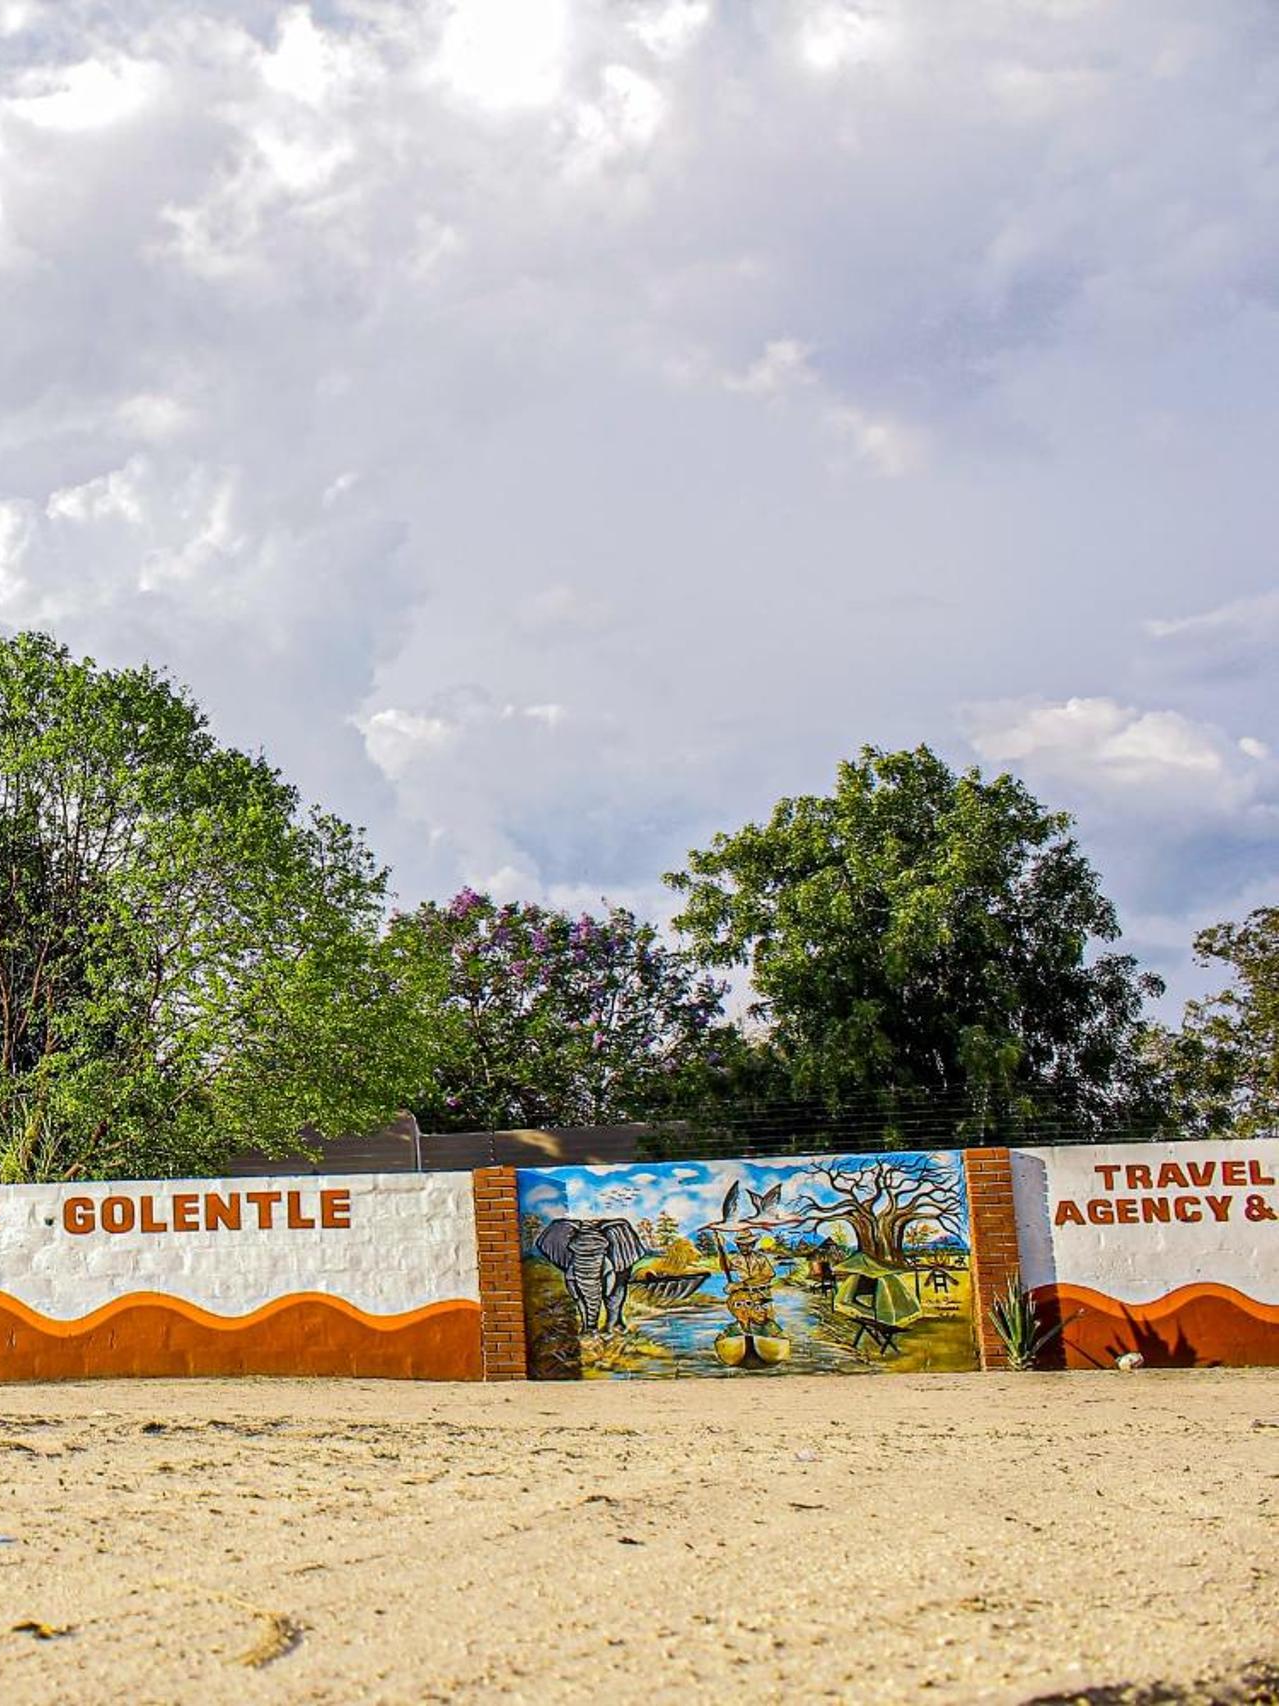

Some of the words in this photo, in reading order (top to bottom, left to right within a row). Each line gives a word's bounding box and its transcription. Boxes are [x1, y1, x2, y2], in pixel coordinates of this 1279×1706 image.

[1094, 1160, 1275, 1191] TRAVEL
[62, 1189, 351, 1234] GOLENTLE
[1054, 1195, 1233, 1226] AGENCY
[1245, 1194, 1278, 1222] &
